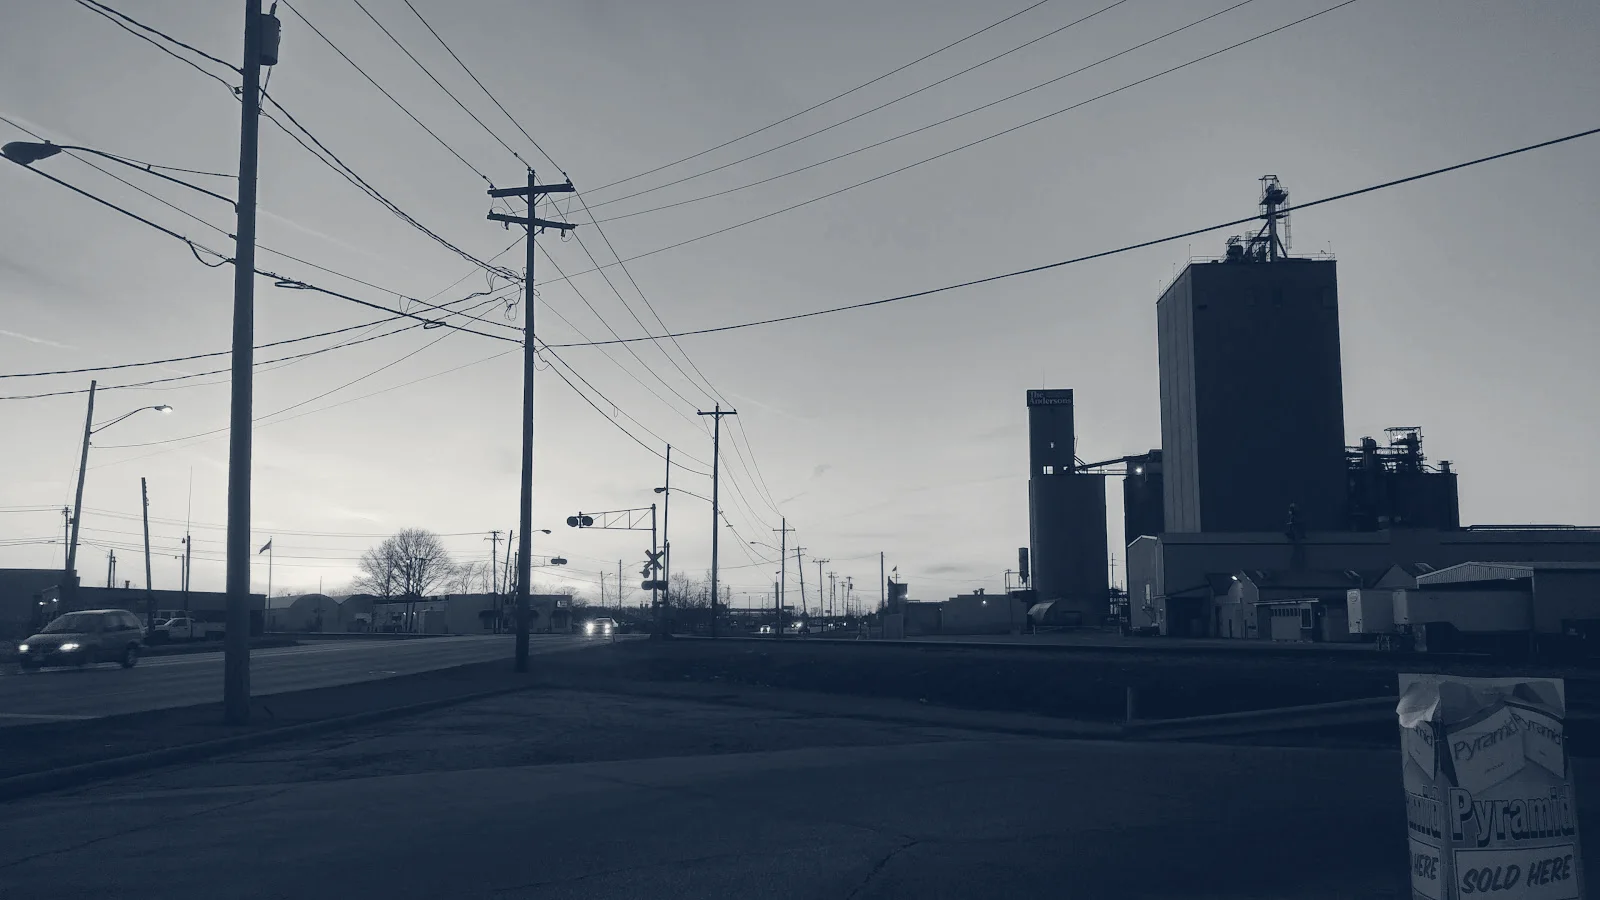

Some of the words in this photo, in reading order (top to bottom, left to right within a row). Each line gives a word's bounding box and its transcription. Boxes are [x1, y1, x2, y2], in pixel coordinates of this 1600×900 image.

[1030, 397, 1072, 405] Andersons
[1454, 716, 1519, 762] Pyramid
[1511, 712, 1562, 746] Pyramid
[1449, 783, 1576, 848] Pyramid
[1460, 864, 1521, 894] SOLD
[1526, 854, 1573, 888] HERE
